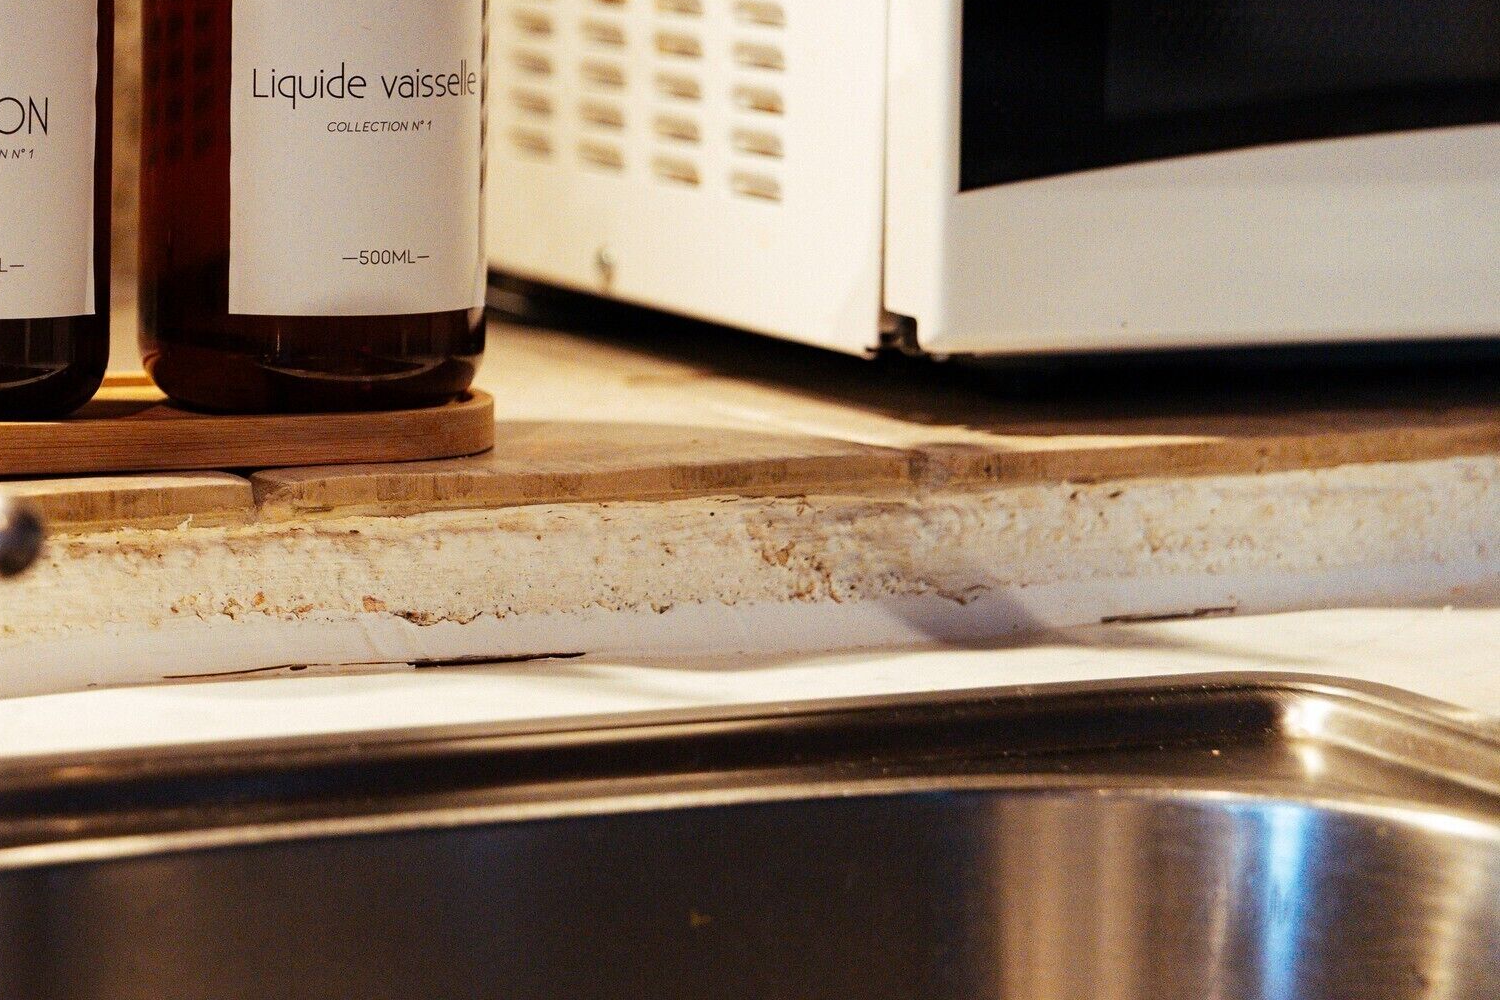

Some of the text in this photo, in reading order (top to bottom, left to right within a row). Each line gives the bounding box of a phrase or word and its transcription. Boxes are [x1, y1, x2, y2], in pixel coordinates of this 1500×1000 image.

[252, 59, 476, 109] Liquide vaisselle
[326, 121, 409, 133] COLLECTION
